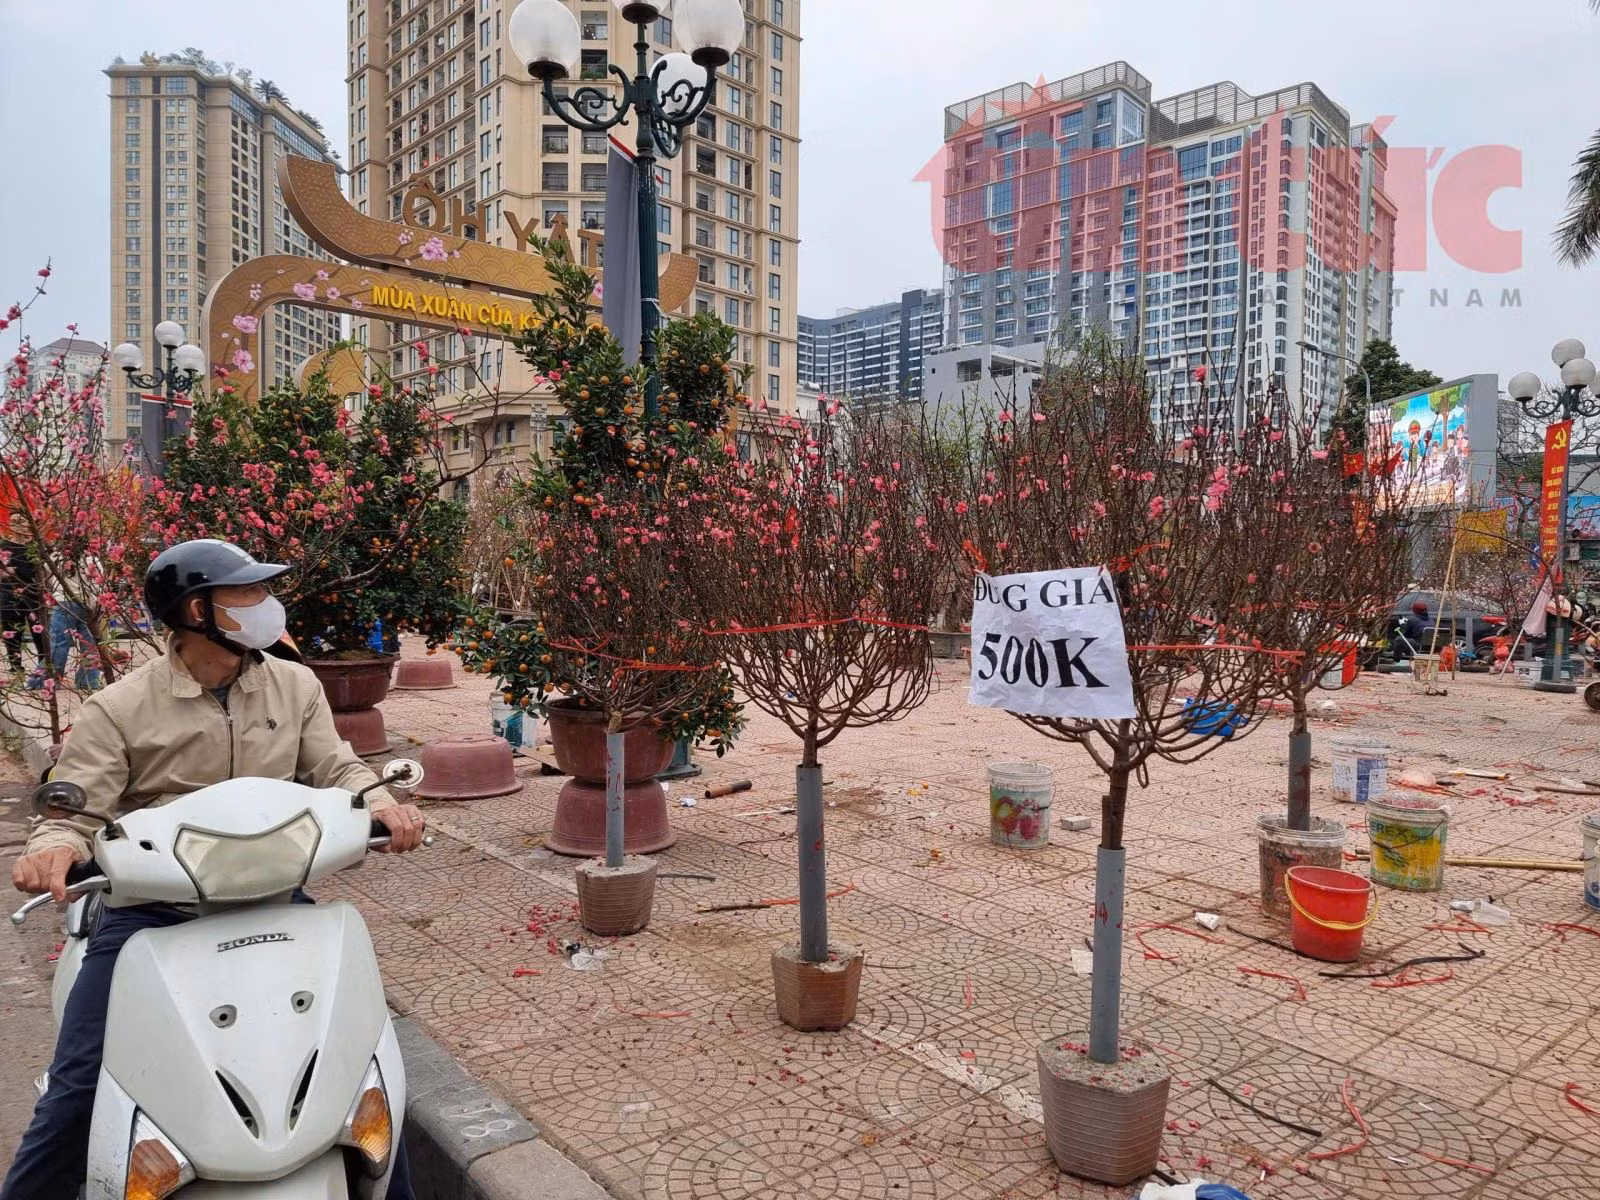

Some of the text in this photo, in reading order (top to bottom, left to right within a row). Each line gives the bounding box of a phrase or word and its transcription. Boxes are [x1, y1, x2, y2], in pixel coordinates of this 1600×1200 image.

[373, 284, 416, 313] MÙA
[421, 294, 472, 321] XUÂN
[478, 302, 514, 329] CỦA
[978, 632, 1110, 689] 500K
[217, 932, 292, 953] HONDA
